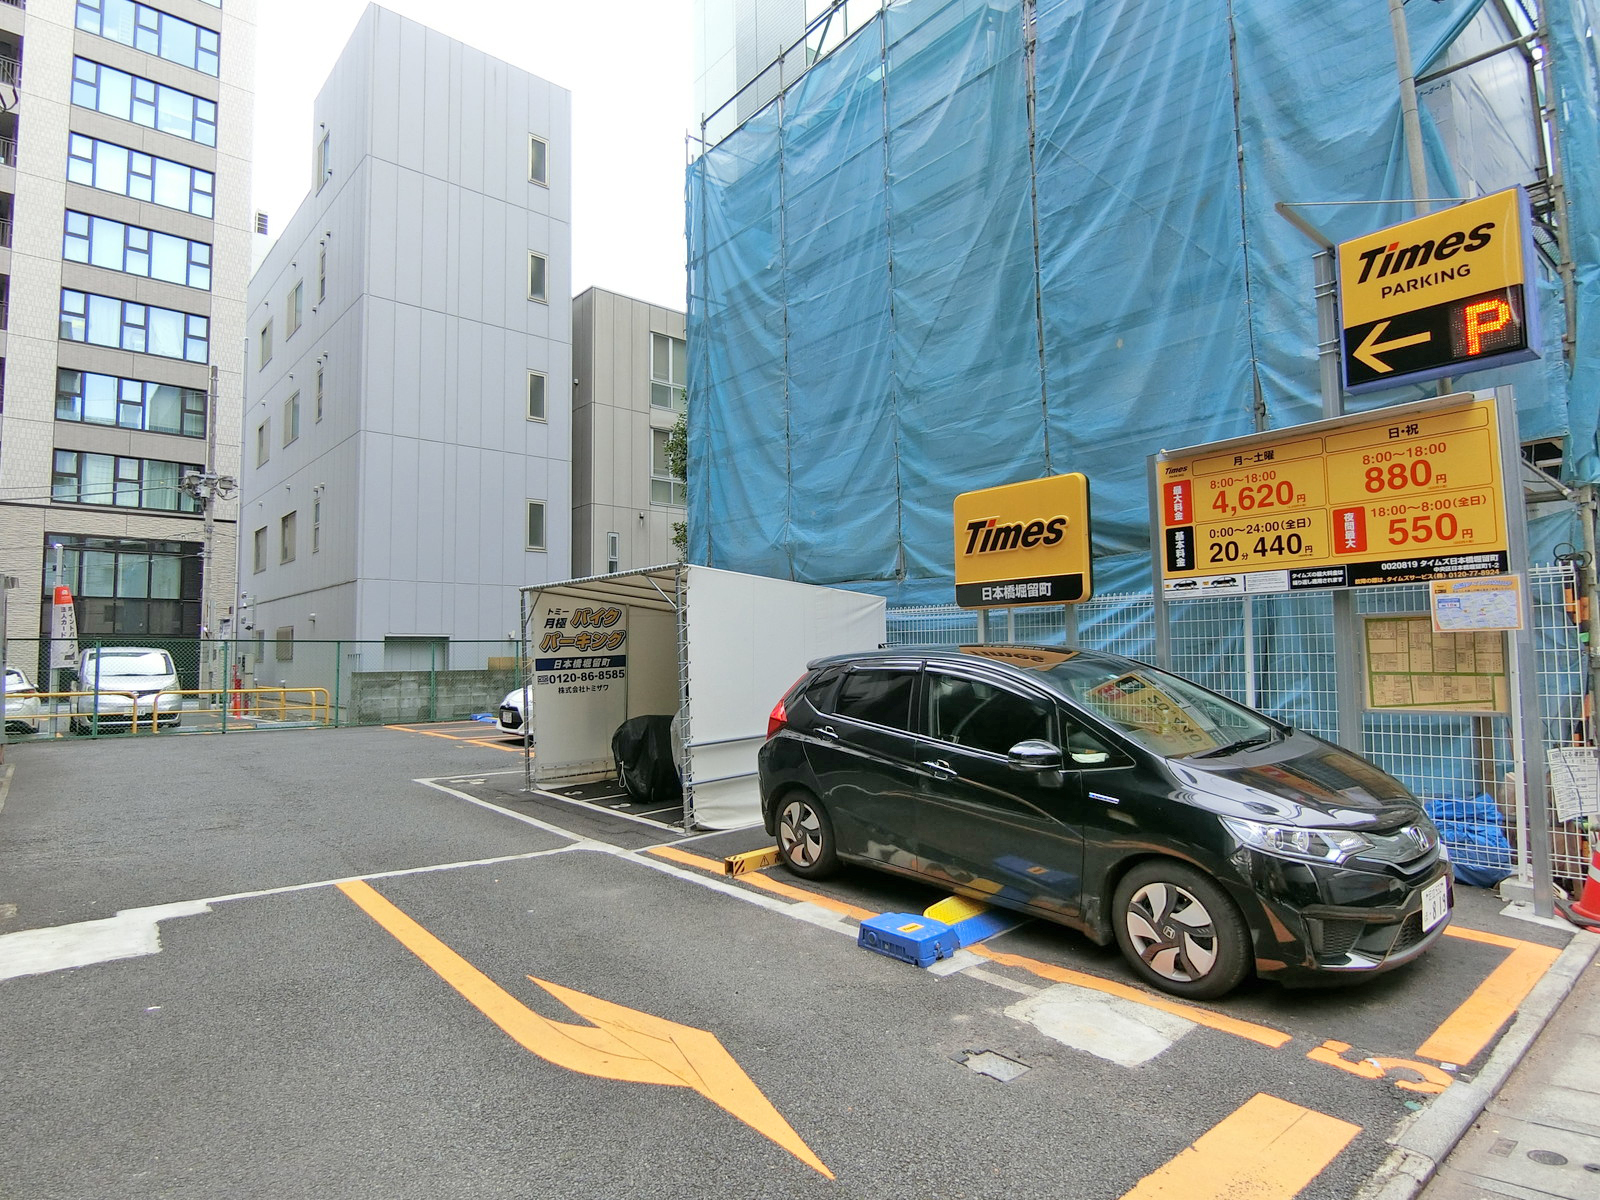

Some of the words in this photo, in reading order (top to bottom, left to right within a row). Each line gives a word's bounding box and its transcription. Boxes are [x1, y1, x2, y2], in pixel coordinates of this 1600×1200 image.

[1357, 222, 1496, 284] Times
[1381, 264, 1471, 299] PARKING
[1464, 299, 1511, 356] P
[1165, 465, 1188, 475] Times
[1173, 485, 1184, 521] 最大料金
[965, 517, 1067, 555] Times
[1343, 512, 1356, 549] 夜間最大
[1175, 531, 1186, 567] 基本料金
[1381, 561, 1418, 571] 0020819
[981, 582, 1052, 601] 日本橋堀留町
[547, 608, 570, 616] トミー
[570, 607, 622, 628] バイク
[544, 618, 568, 629] 月極
[539, 630, 626, 652] パーキング
[553, 658, 611, 669] 日本橋堀留町
[549, 670, 625, 684] 0120-86-8585
[558, 684, 609, 694] 株式会社トミザワ
[1305, 1039, 1454, 1095] 5
